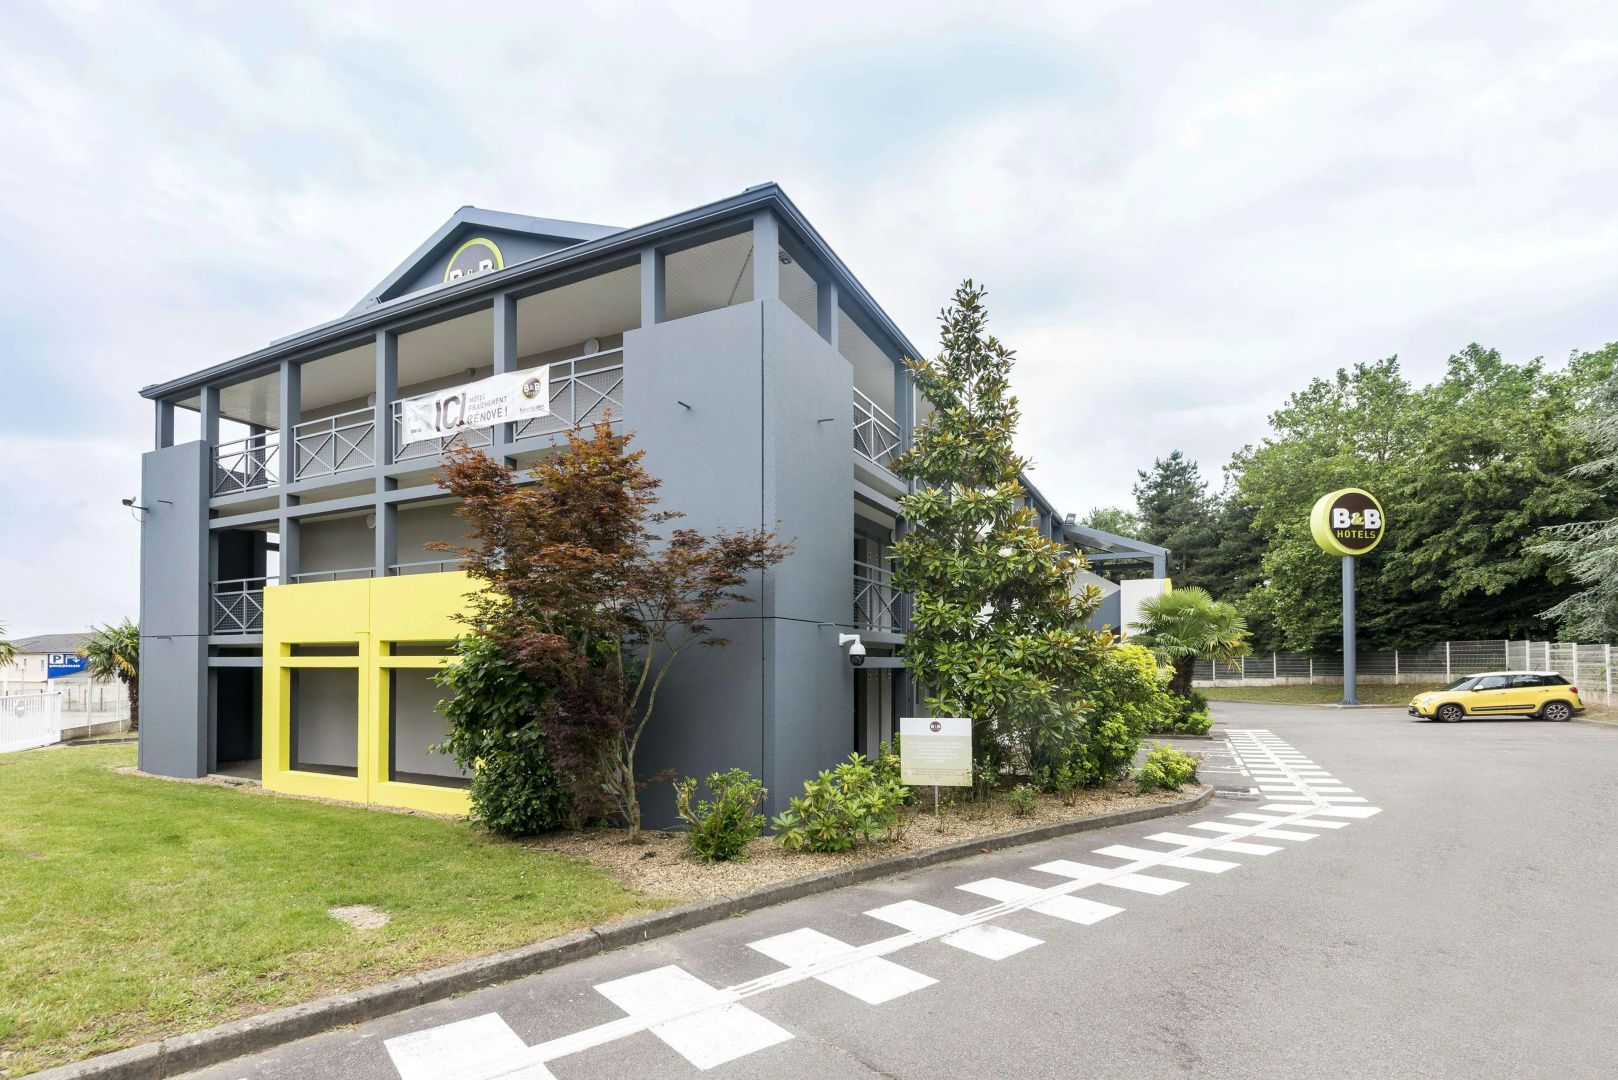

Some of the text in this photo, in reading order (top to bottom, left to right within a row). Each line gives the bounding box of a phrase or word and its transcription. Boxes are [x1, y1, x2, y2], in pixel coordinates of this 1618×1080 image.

[523, 382, 540, 393] B&B
[468, 393, 486, 404] HÔTEL
[468, 395, 508, 411] FRAÎCHEMENT
[435, 392, 467, 432] ICI
[466, 404, 503, 425] RÉNOVÉ
[1333, 507, 1382, 529] B&B
[1336, 529, 1376, 539] HOTELS
